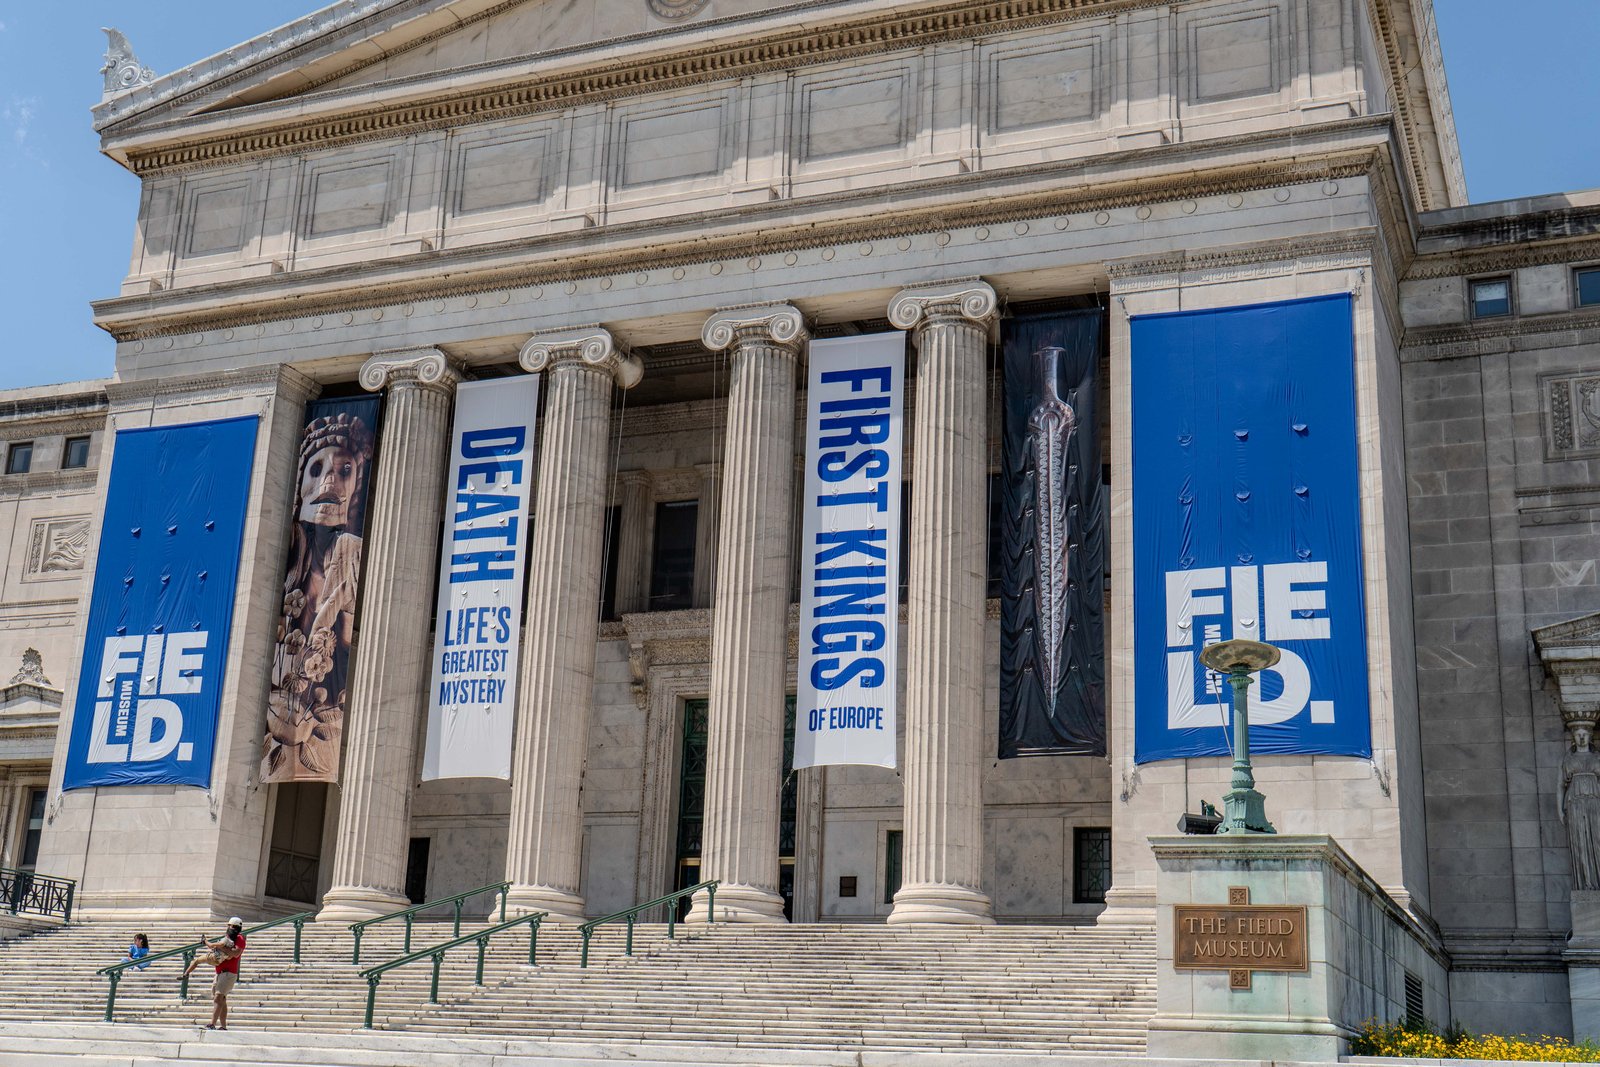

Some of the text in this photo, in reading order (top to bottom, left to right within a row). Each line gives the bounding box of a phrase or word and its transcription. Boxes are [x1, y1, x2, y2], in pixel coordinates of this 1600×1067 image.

[449, 425, 527, 584] DEATH
[810, 365, 892, 691] FIRST KINGS
[444, 606, 511, 647] LIFE'S
[441, 649, 509, 675] GREATEST
[1204, 624, 1223, 694] MUUM
[115, 680, 133, 737] MUSEUM
[439, 678, 506, 706] MYSTERY
[808, 706, 884, 732] OF EUROPE
[1185, 917, 1294, 936] THE FIELD
[1193, 939, 1286, 959] MUSEUM
